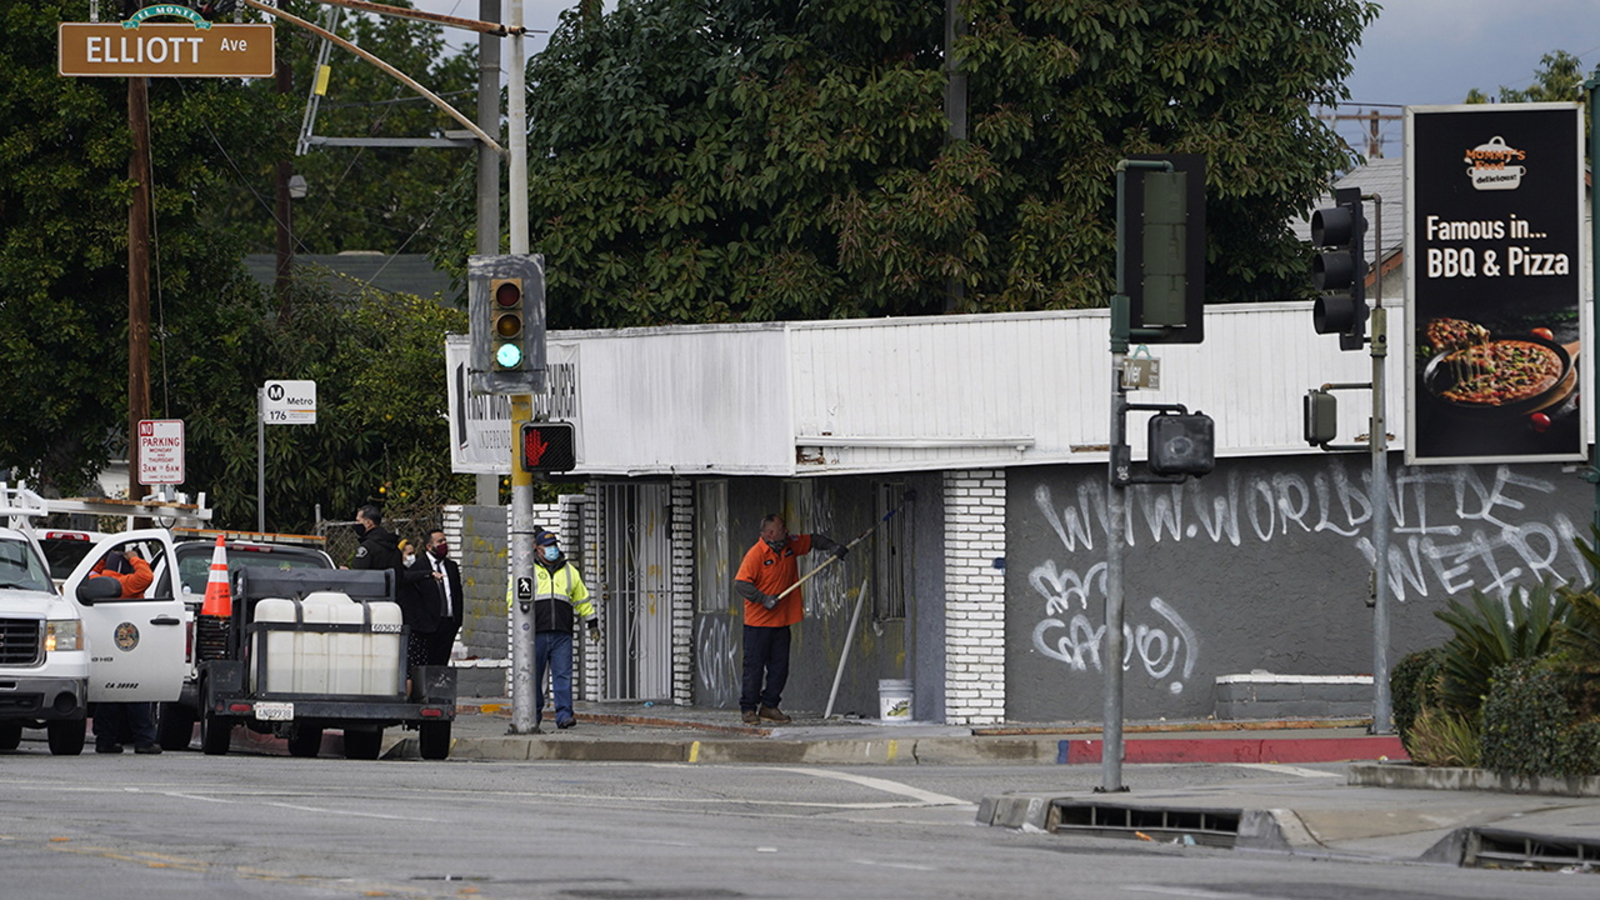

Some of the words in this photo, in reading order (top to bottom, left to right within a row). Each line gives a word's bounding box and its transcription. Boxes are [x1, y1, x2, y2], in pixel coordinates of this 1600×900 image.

[138, 11, 149, 19] EL
[156, 7, 195, 19] MONTE
[87, 37, 204, 63] ELLIOTT
[220, 38, 247, 51] Ave
[1475, 160, 1505, 170] Food
[1476, 174, 1518, 184] delicious!
[1427, 215, 1505, 240] Famous
[1510, 214, 1547, 239] in...
[1428, 247, 1477, 278] BBQ
[1482, 250, 1501, 277] &
[1508, 246, 1570, 276] Pizza
[287, 397, 313, 405] Metro
[270, 411, 287, 420] 176
[141, 423, 153, 435] NO
[142, 437, 180, 447] PARKING
[143, 463, 157, 473] 3AM
[165, 464, 180, 472] 6AM
